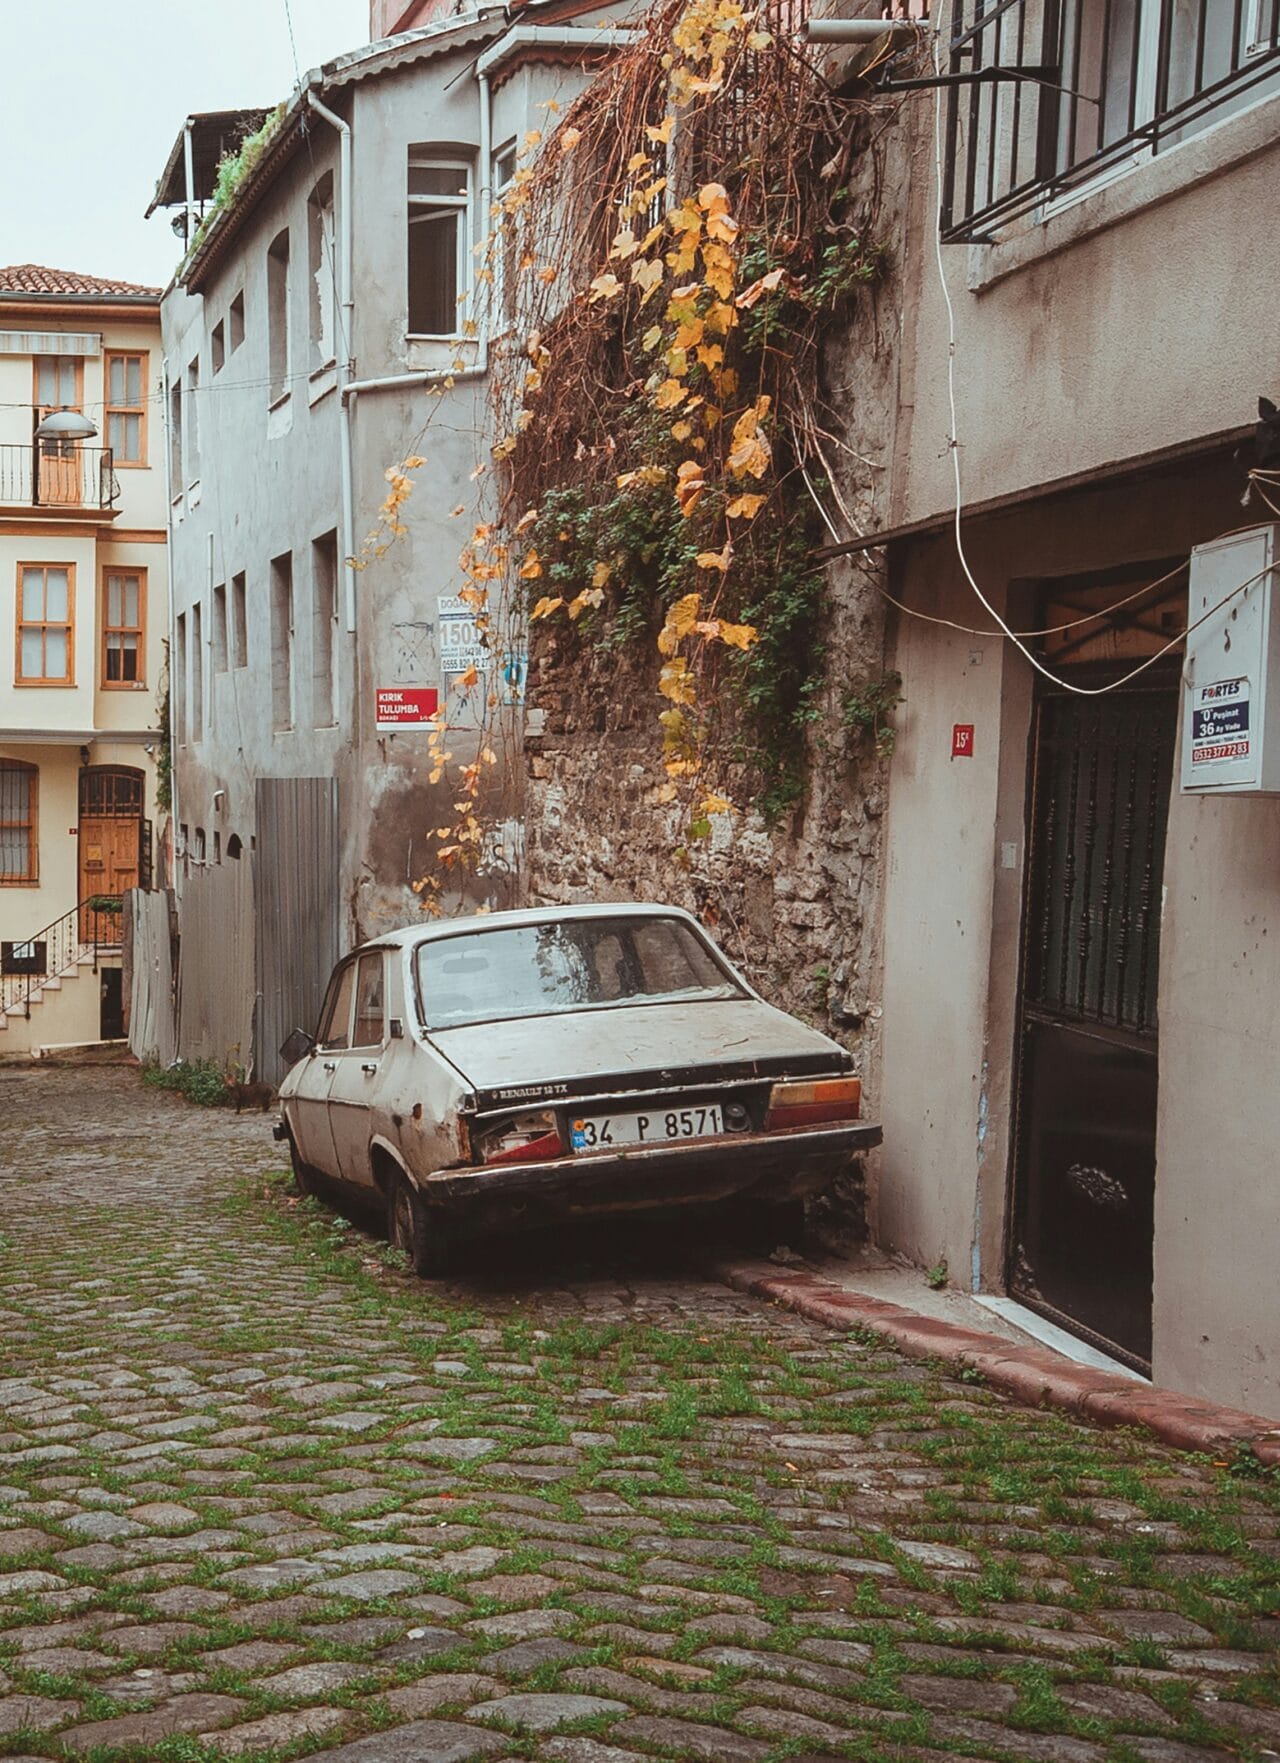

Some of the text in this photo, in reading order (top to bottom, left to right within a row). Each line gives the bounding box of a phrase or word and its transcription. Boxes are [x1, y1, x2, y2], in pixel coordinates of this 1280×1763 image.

[379, 693, 403, 702] KIRIK
[1201, 681, 1240, 701] FORTES
[379, 704, 420, 714] TULUMBA
[1200, 722, 1214, 737] 36
[500, 1084, 568, 1099] RENAULT 12 TX
[584, 1119, 613, 1146] 34
[637, 1116, 650, 1141] P
[665, 1109, 719, 1137] 8571
